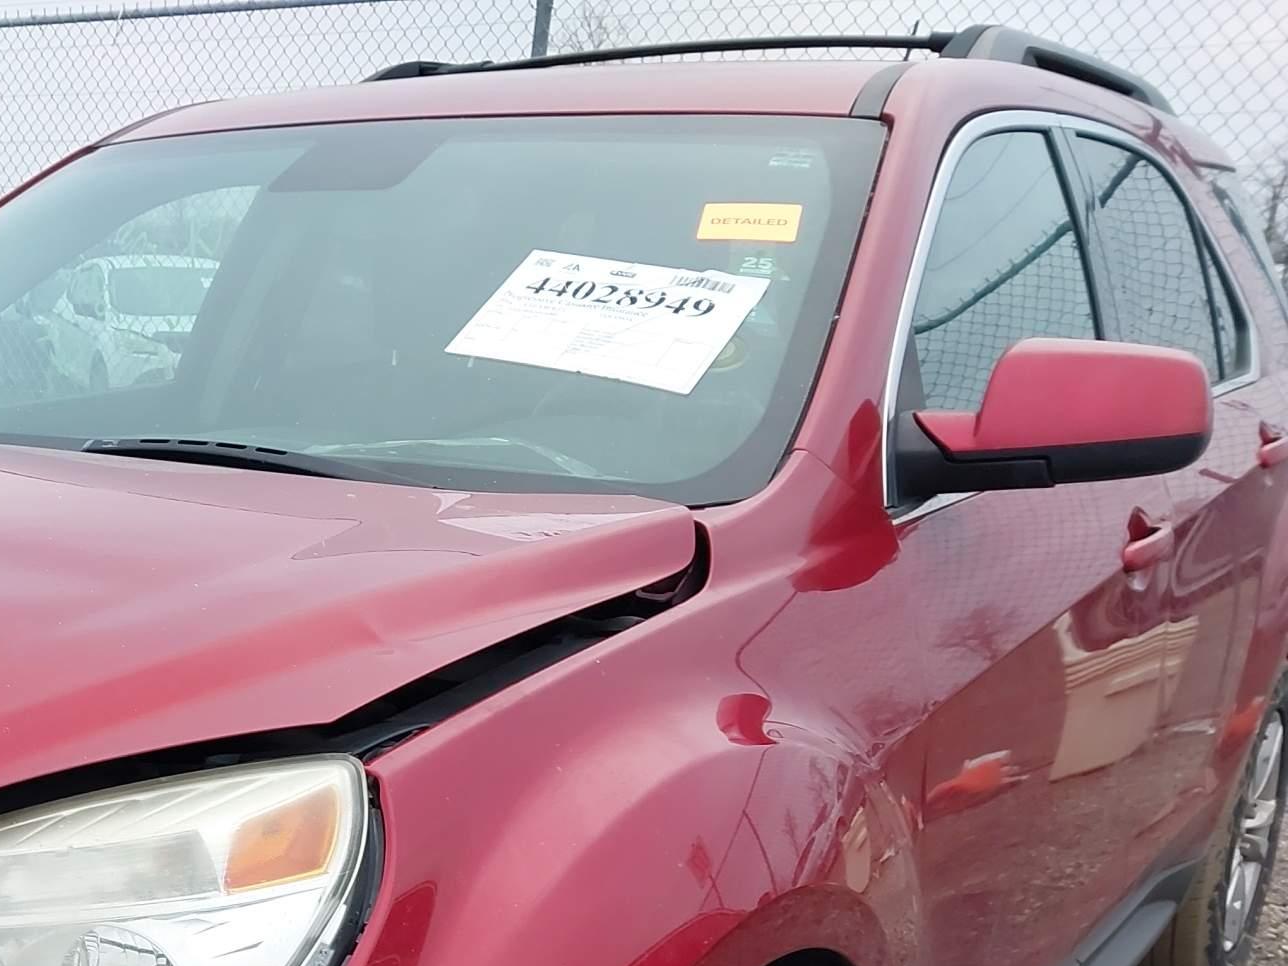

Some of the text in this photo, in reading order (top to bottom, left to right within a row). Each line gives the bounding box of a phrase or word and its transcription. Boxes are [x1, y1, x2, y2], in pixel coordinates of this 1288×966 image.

[710, 217, 789, 226] DETAILED
[741, 256, 774, 270] 25
[525, 276, 716, 318] 44028949
